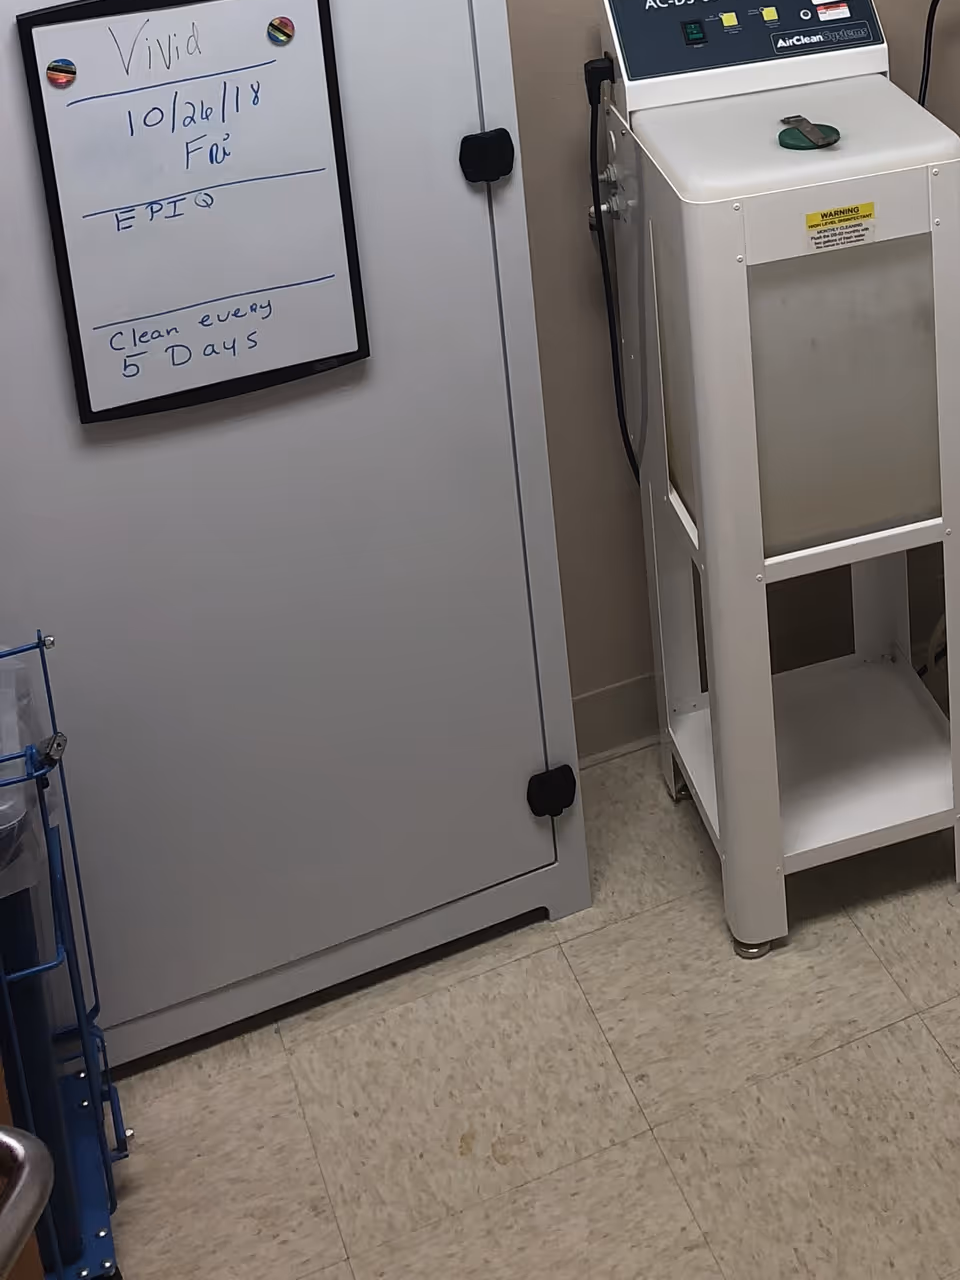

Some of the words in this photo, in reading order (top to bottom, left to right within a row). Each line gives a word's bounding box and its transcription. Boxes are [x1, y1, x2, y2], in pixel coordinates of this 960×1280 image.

[108, 19, 202, 76] Vivid
[128, 80, 261, 136] 10/26/18
[821, 207, 860, 219] WARNING
[109, 324, 178, 352] Clean
[165, 330, 259, 368] Days
